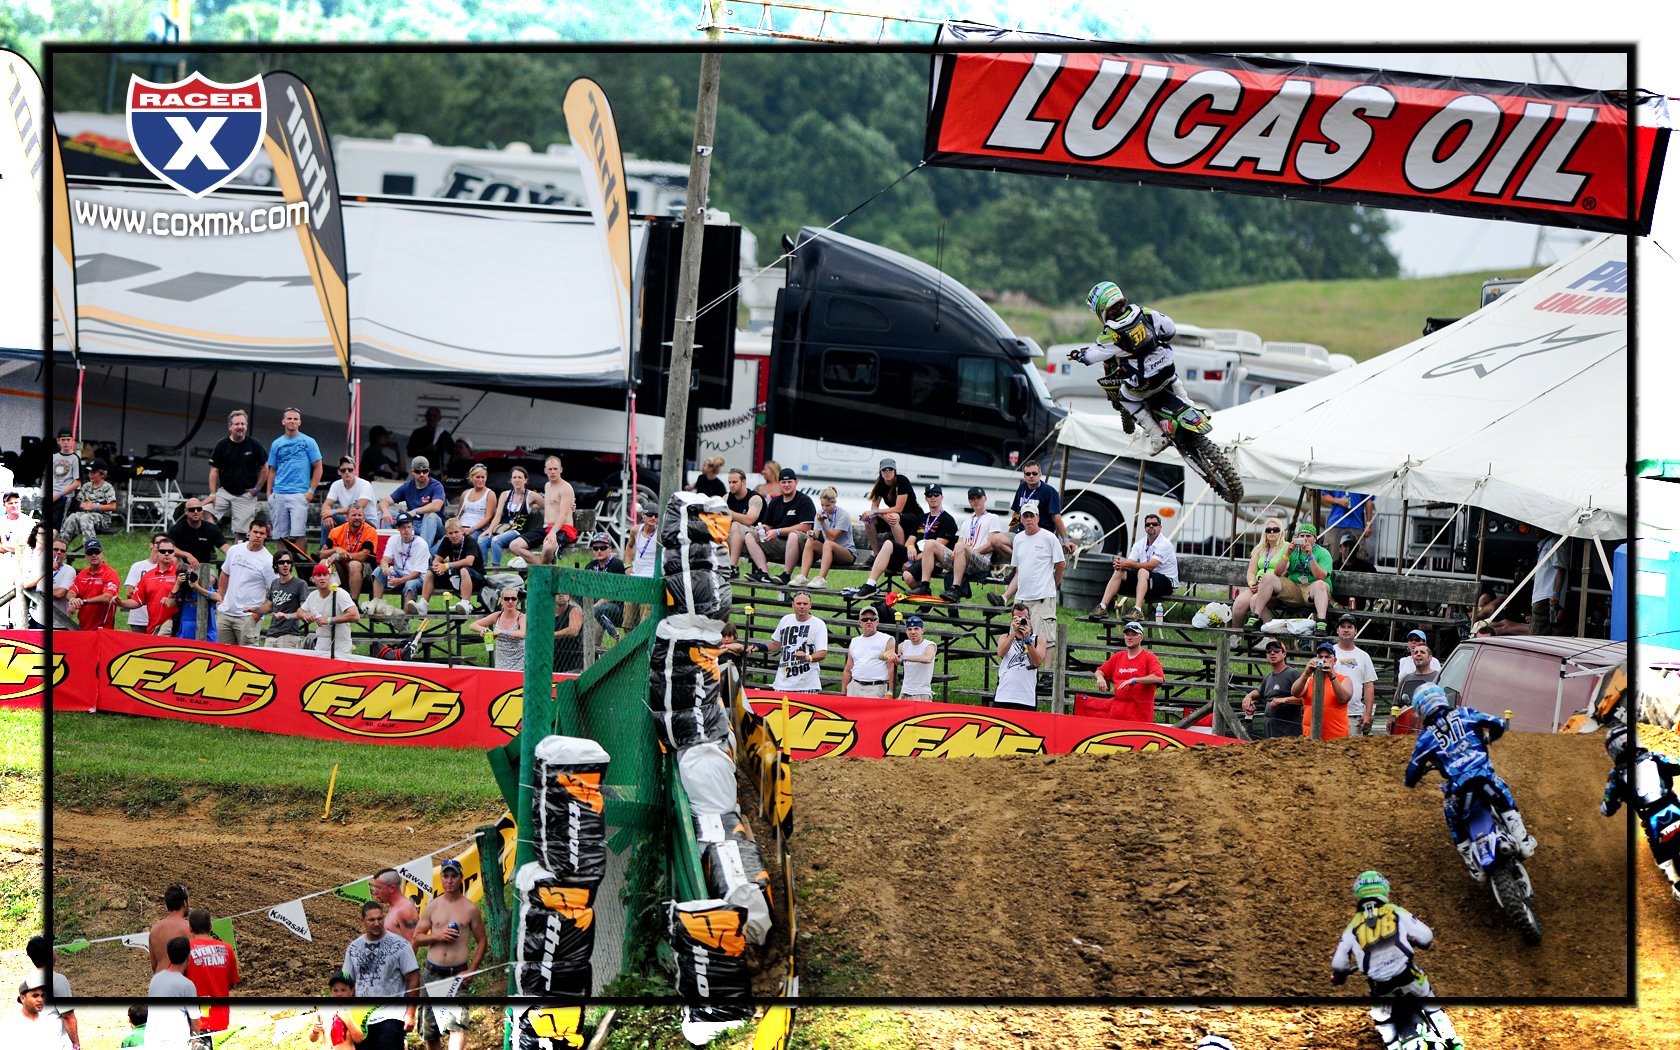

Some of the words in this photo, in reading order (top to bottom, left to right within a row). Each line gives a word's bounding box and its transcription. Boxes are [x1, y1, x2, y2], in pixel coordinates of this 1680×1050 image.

[983, 53, 1399, 185] LUCAS
[1402, 93, 1598, 207] OIL
[109, 655, 276, 702] FMF
[785, 662, 811, 678] 2010
[301, 681, 462, 722] FMF
[763, 708, 858, 752] MF
[884, 722, 1045, 758] FMF
[567, 800, 580, 873] thor
[270, 909, 309, 936] Kawasaki
[539, 913, 562, 992] thor
[692, 944, 712, 1015] tho
